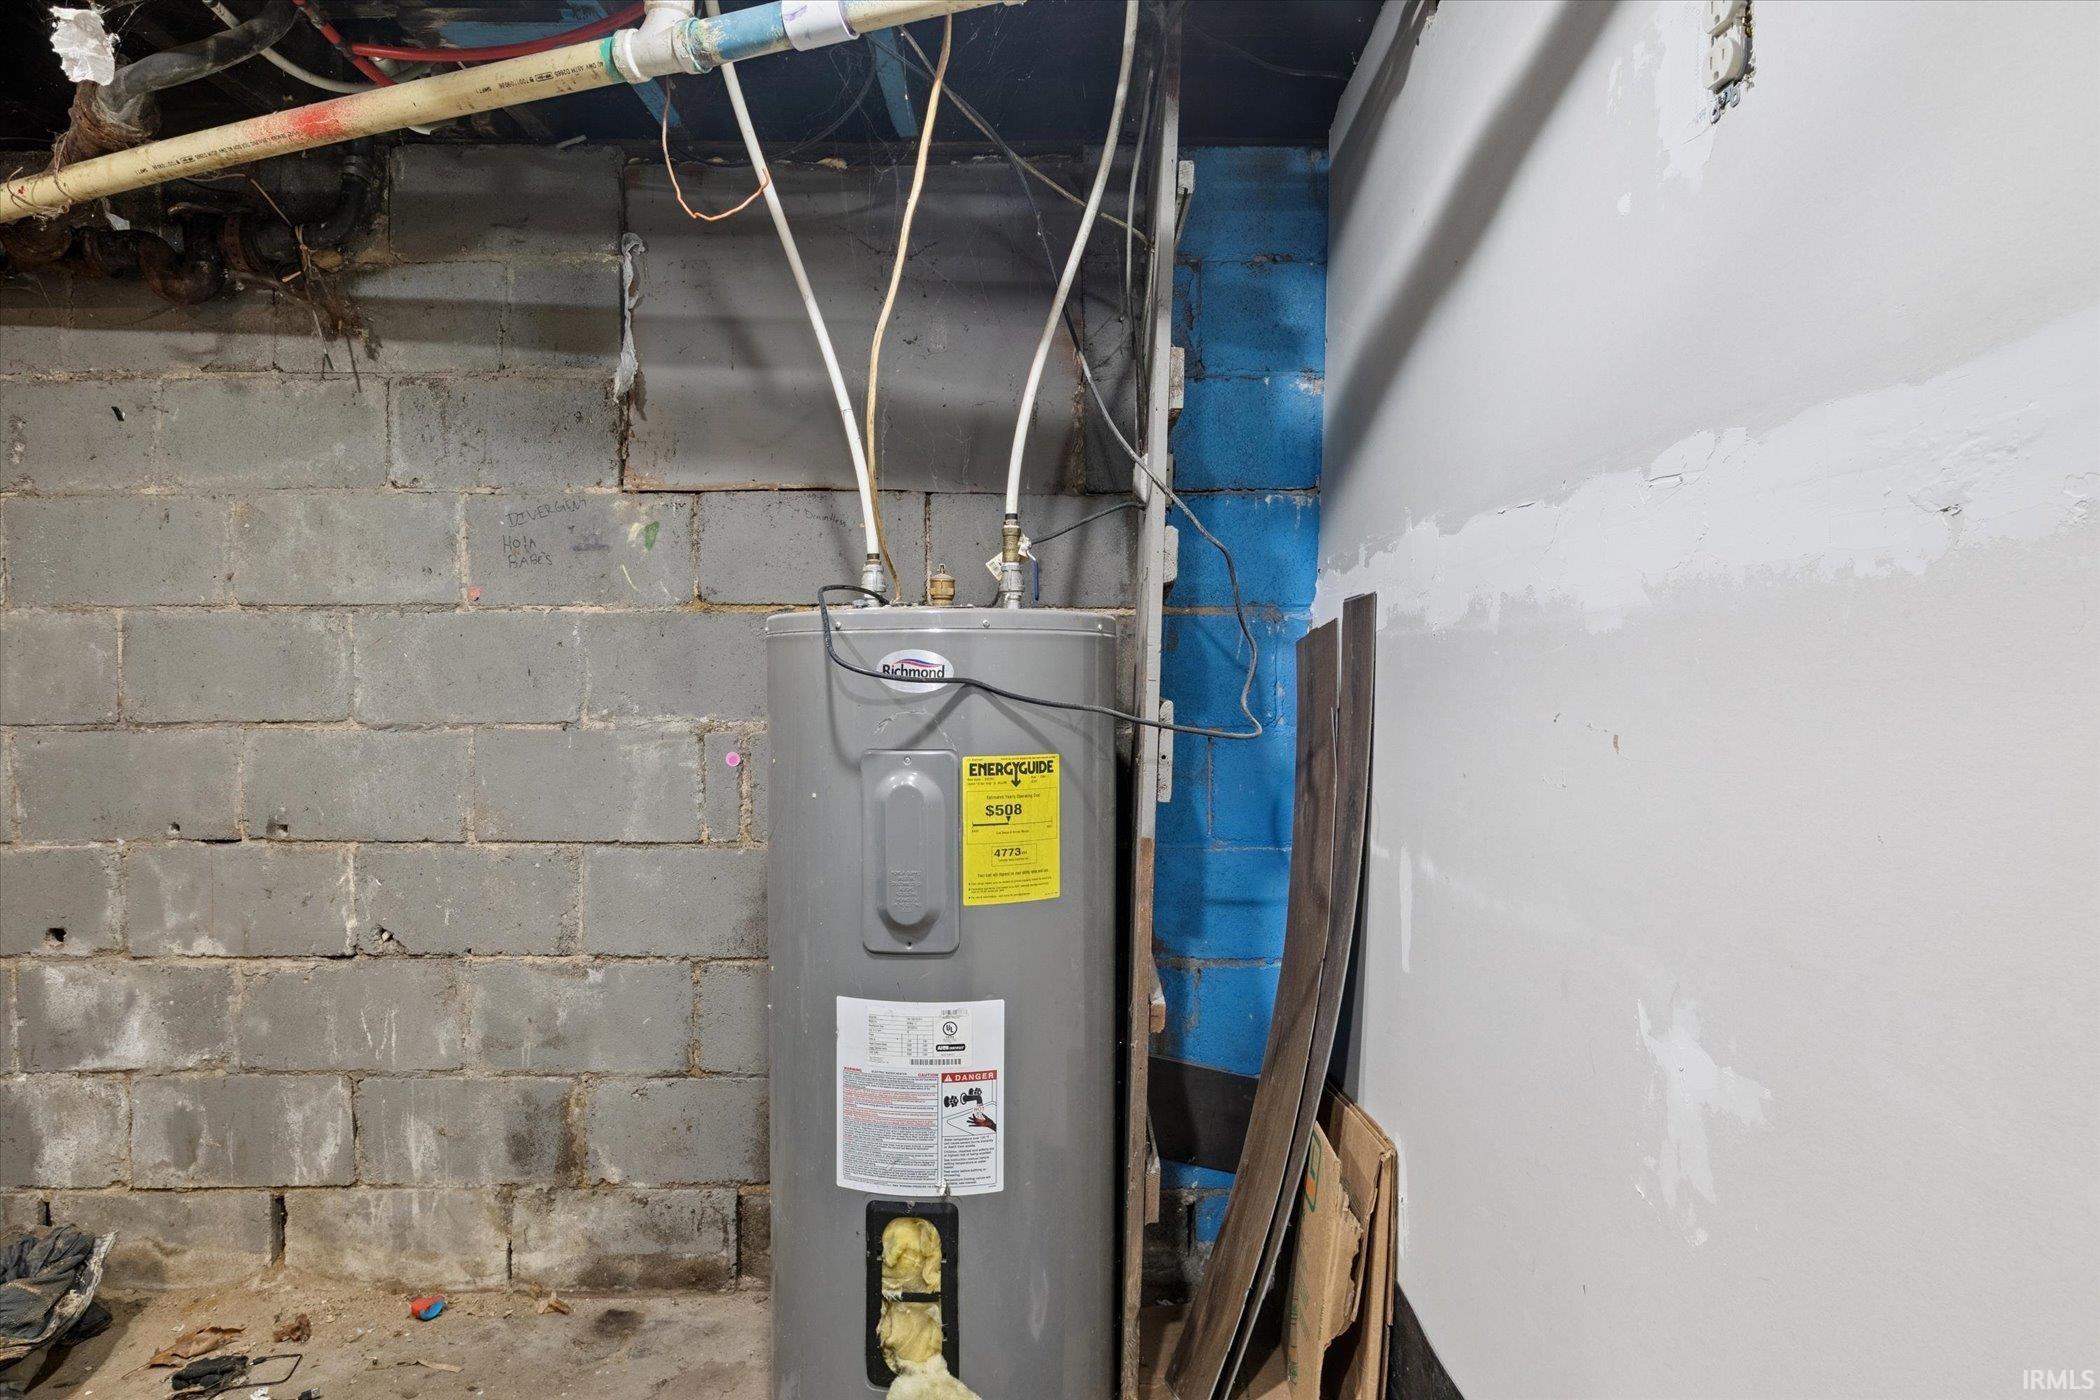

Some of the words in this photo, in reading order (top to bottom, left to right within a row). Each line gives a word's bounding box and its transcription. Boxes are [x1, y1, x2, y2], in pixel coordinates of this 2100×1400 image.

[882, 664, 945, 678] Richmond
[969, 760, 1054, 777] ENERGYGUIDE
[985, 803, 1022, 816] $508
[994, 847, 1022, 857] 4773
[954, 1072, 994, 1081] DANGER
